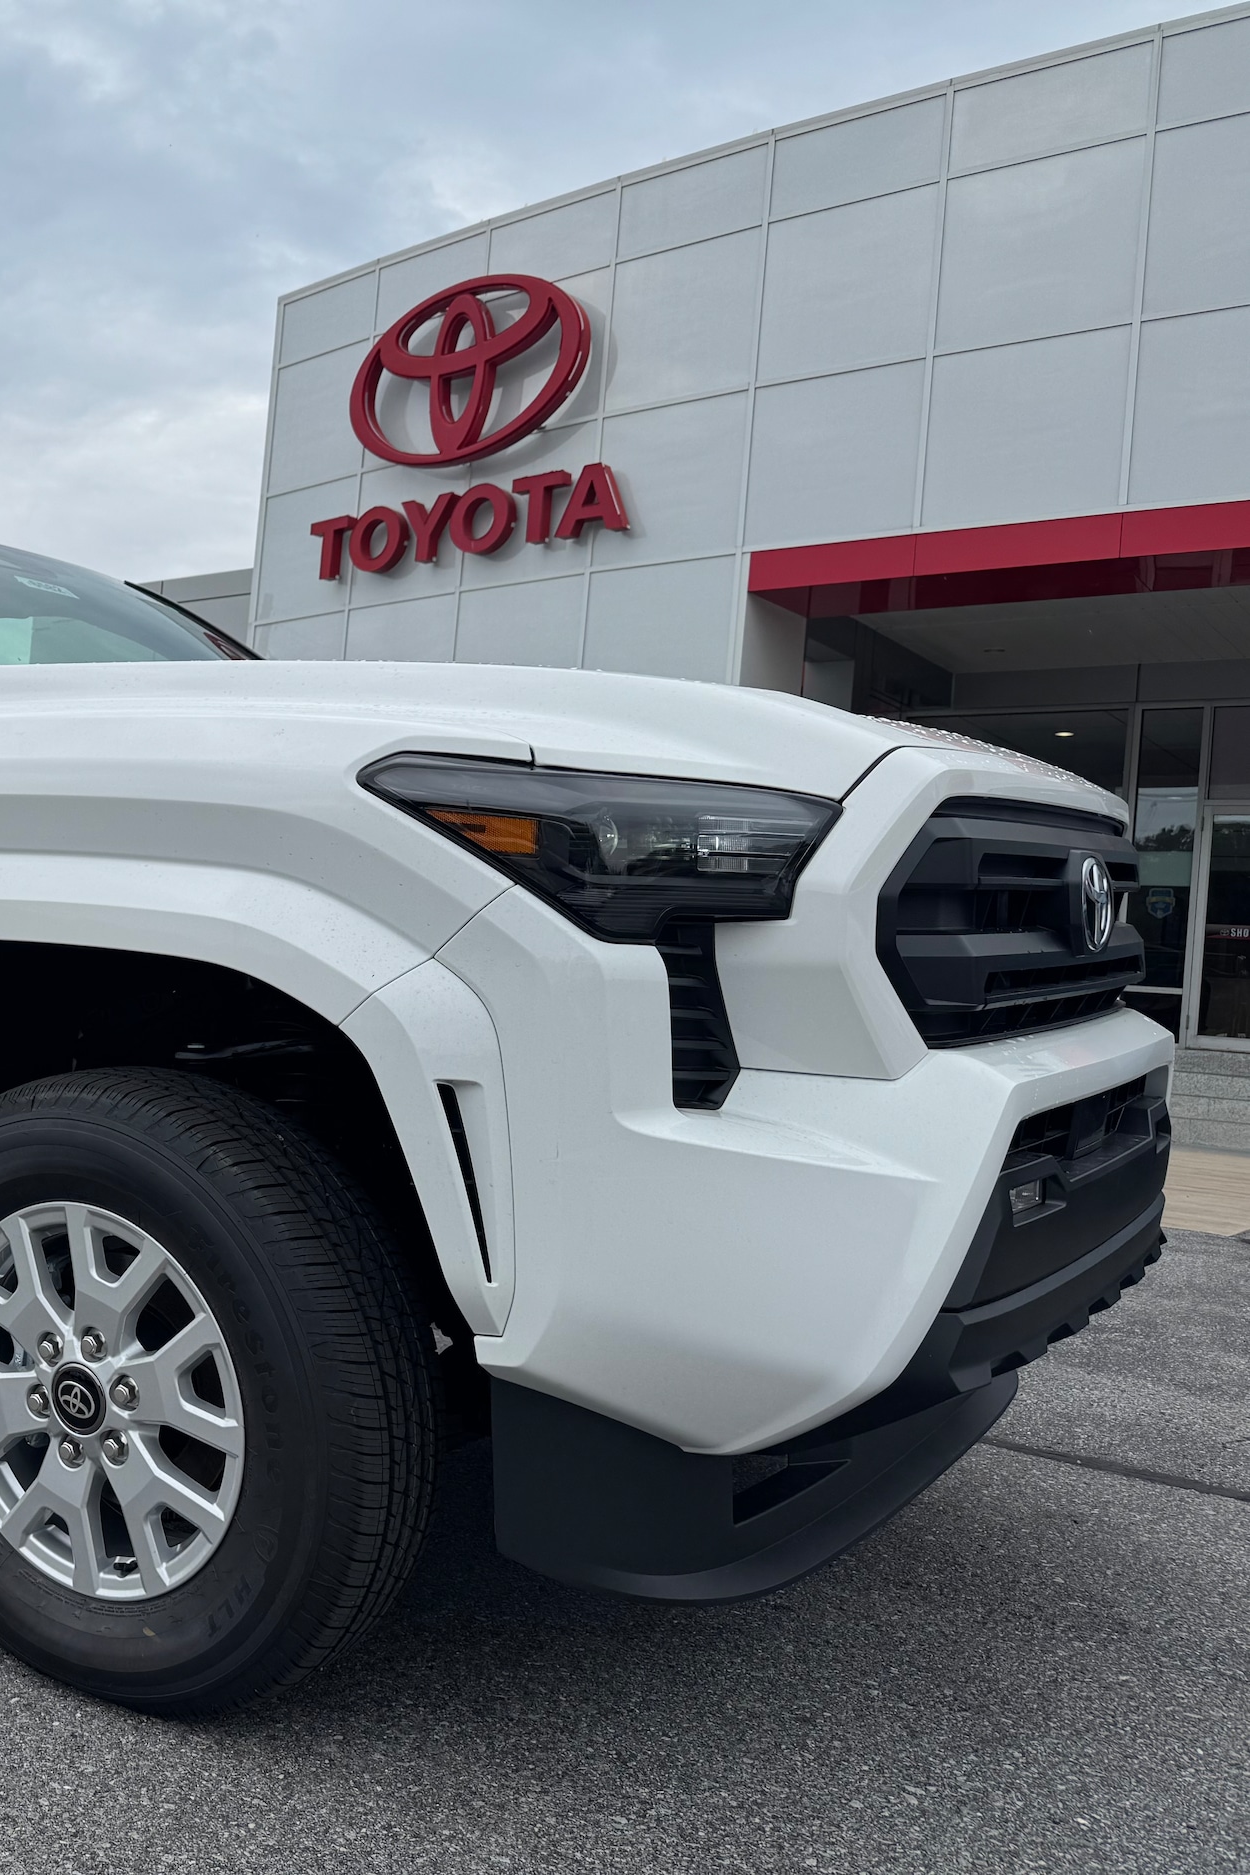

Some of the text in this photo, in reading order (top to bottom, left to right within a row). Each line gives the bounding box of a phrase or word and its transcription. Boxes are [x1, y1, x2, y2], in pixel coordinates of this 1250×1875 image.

[310, 462, 630, 581] TOYOTA
[1230, 927, 1250, 938] SHO
[188, 1223, 284, 1486] Firestone
